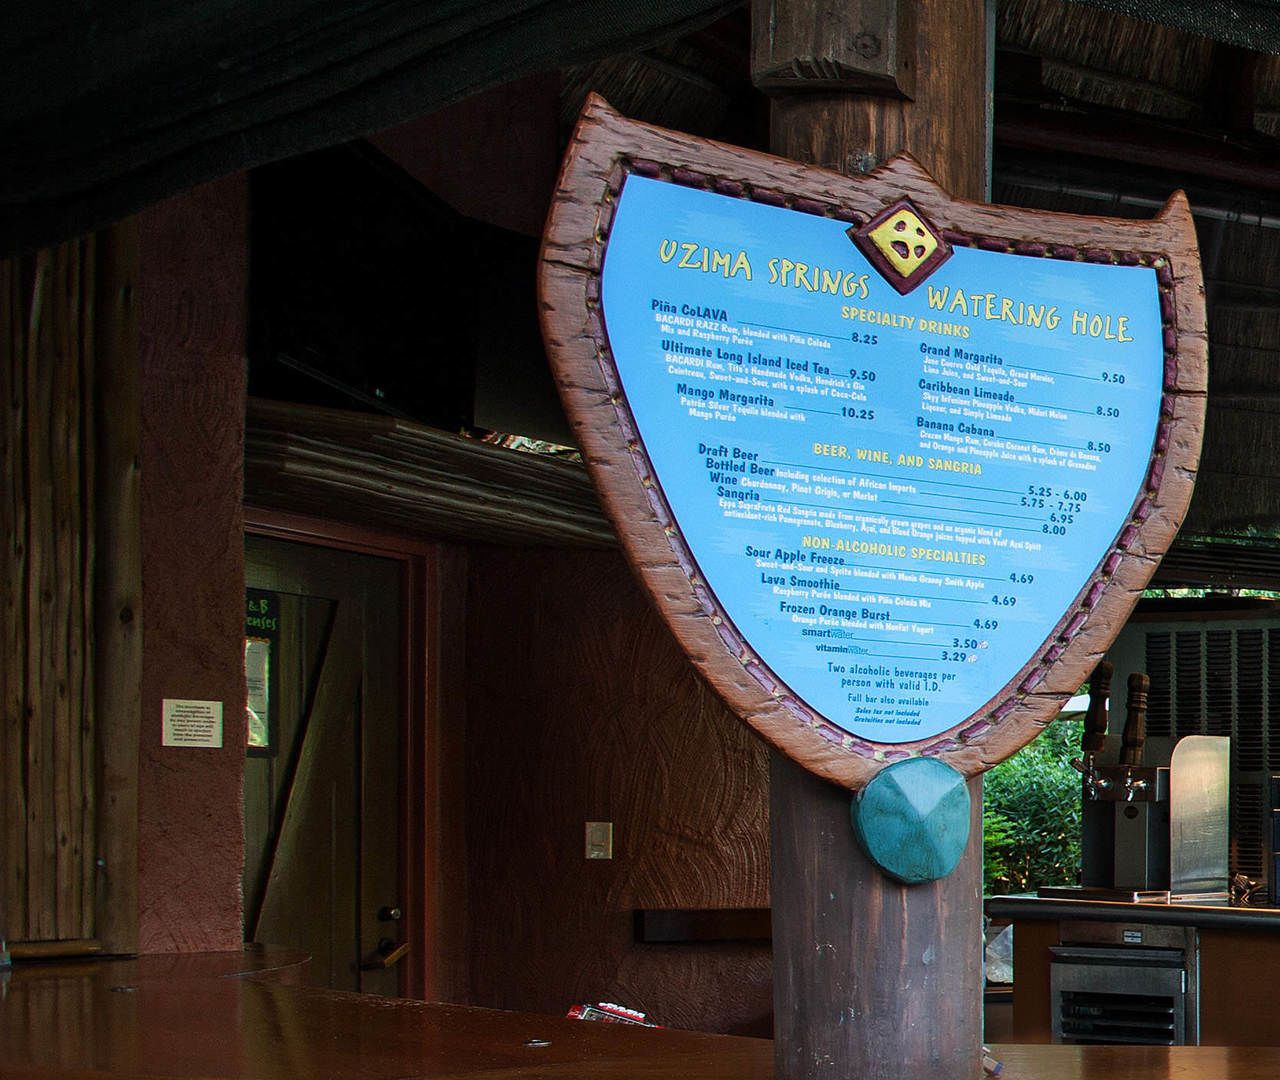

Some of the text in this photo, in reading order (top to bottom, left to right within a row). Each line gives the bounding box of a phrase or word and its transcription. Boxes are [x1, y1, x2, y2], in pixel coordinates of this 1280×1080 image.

[659, 239, 1134, 343] UZIMA SPRINGS WATERING HOLE
[651, 299, 878, 345] Piña CoLAVA 8.25
[655, 313, 831, 349] BACARDI RAZZ blended with Colada
[677, 327, 730, 344] and Raspberry
[841, 305, 971, 340] SPECIALTY DRINKS
[661, 340, 876, 382] Ultimate Long Island Iced Tea 9.50
[664, 353, 850, 389] BACARDI Handmade Hendrick's
[920, 342, 1125, 385] Grand Margarita 9.50
[923, 365, 974, 380] Lime and
[677, 383, 875, 420] Mango Margarita 10.25
[772, 381, 787, 390] with
[796, 384, 818, 394] splash
[820, 387, 828, 396] of
[831, 388, 867, 401] Coca-Cola
[918, 378, 1120, 418] Caribbean Limeade 8.50
[688, 408, 713, 420] Mango
[708, 401, 806, 422] Silver Tequila blended with
[949, 406, 962, 415] and
[916, 416, 1111, 453] Banana Cabana 8.50
[812, 442, 983, 476] BEER, WINE, AND SANGRIA
[919, 441, 1032, 462] and Orange and Pineapple with
[698, 443, 1087, 502] Draft Beer 5.25 6.00
[706, 457, 1081, 513] Bottled Beer Including selection of African Imports 5.75 7.75
[710, 471, 1074, 525] Wine Pinot or Merlot 6.95
[716, 485, 1066, 536] Sangria 8.00
[777, 504, 854, 520] Red Sangria made from
[879, 526, 891, 534] and
[745, 546, 1034, 584] Sour Apple Freeze 4.69
[802, 536, 986, 566] NON-ALCOHOLIC SPECIALTIES
[755, 559, 985, 590] Sweet-and-Sour and Sprite blended with Granny Smith Apple
[761, 572, 1017, 607] Lava Smoothie 4.69
[772, 586, 932, 609] Raspberry blended with Colada Mix
[780, 601, 998, 630] Frozen Orange Burst 4.69
[792, 614, 934, 636] Orange blended with Nonfat Yogurt
[802, 628, 978, 649] smartwater 3.50
[815, 643, 967, 662] vitaminwater 3.29
[827, 662, 956, 683] Two alcoholic beverages per
[842, 678, 942, 692] person with valid I.D.
[848, 693, 929, 707] Full bar also available
[895, 709, 920, 717] included
[854, 716, 884, 724] Gratuities
